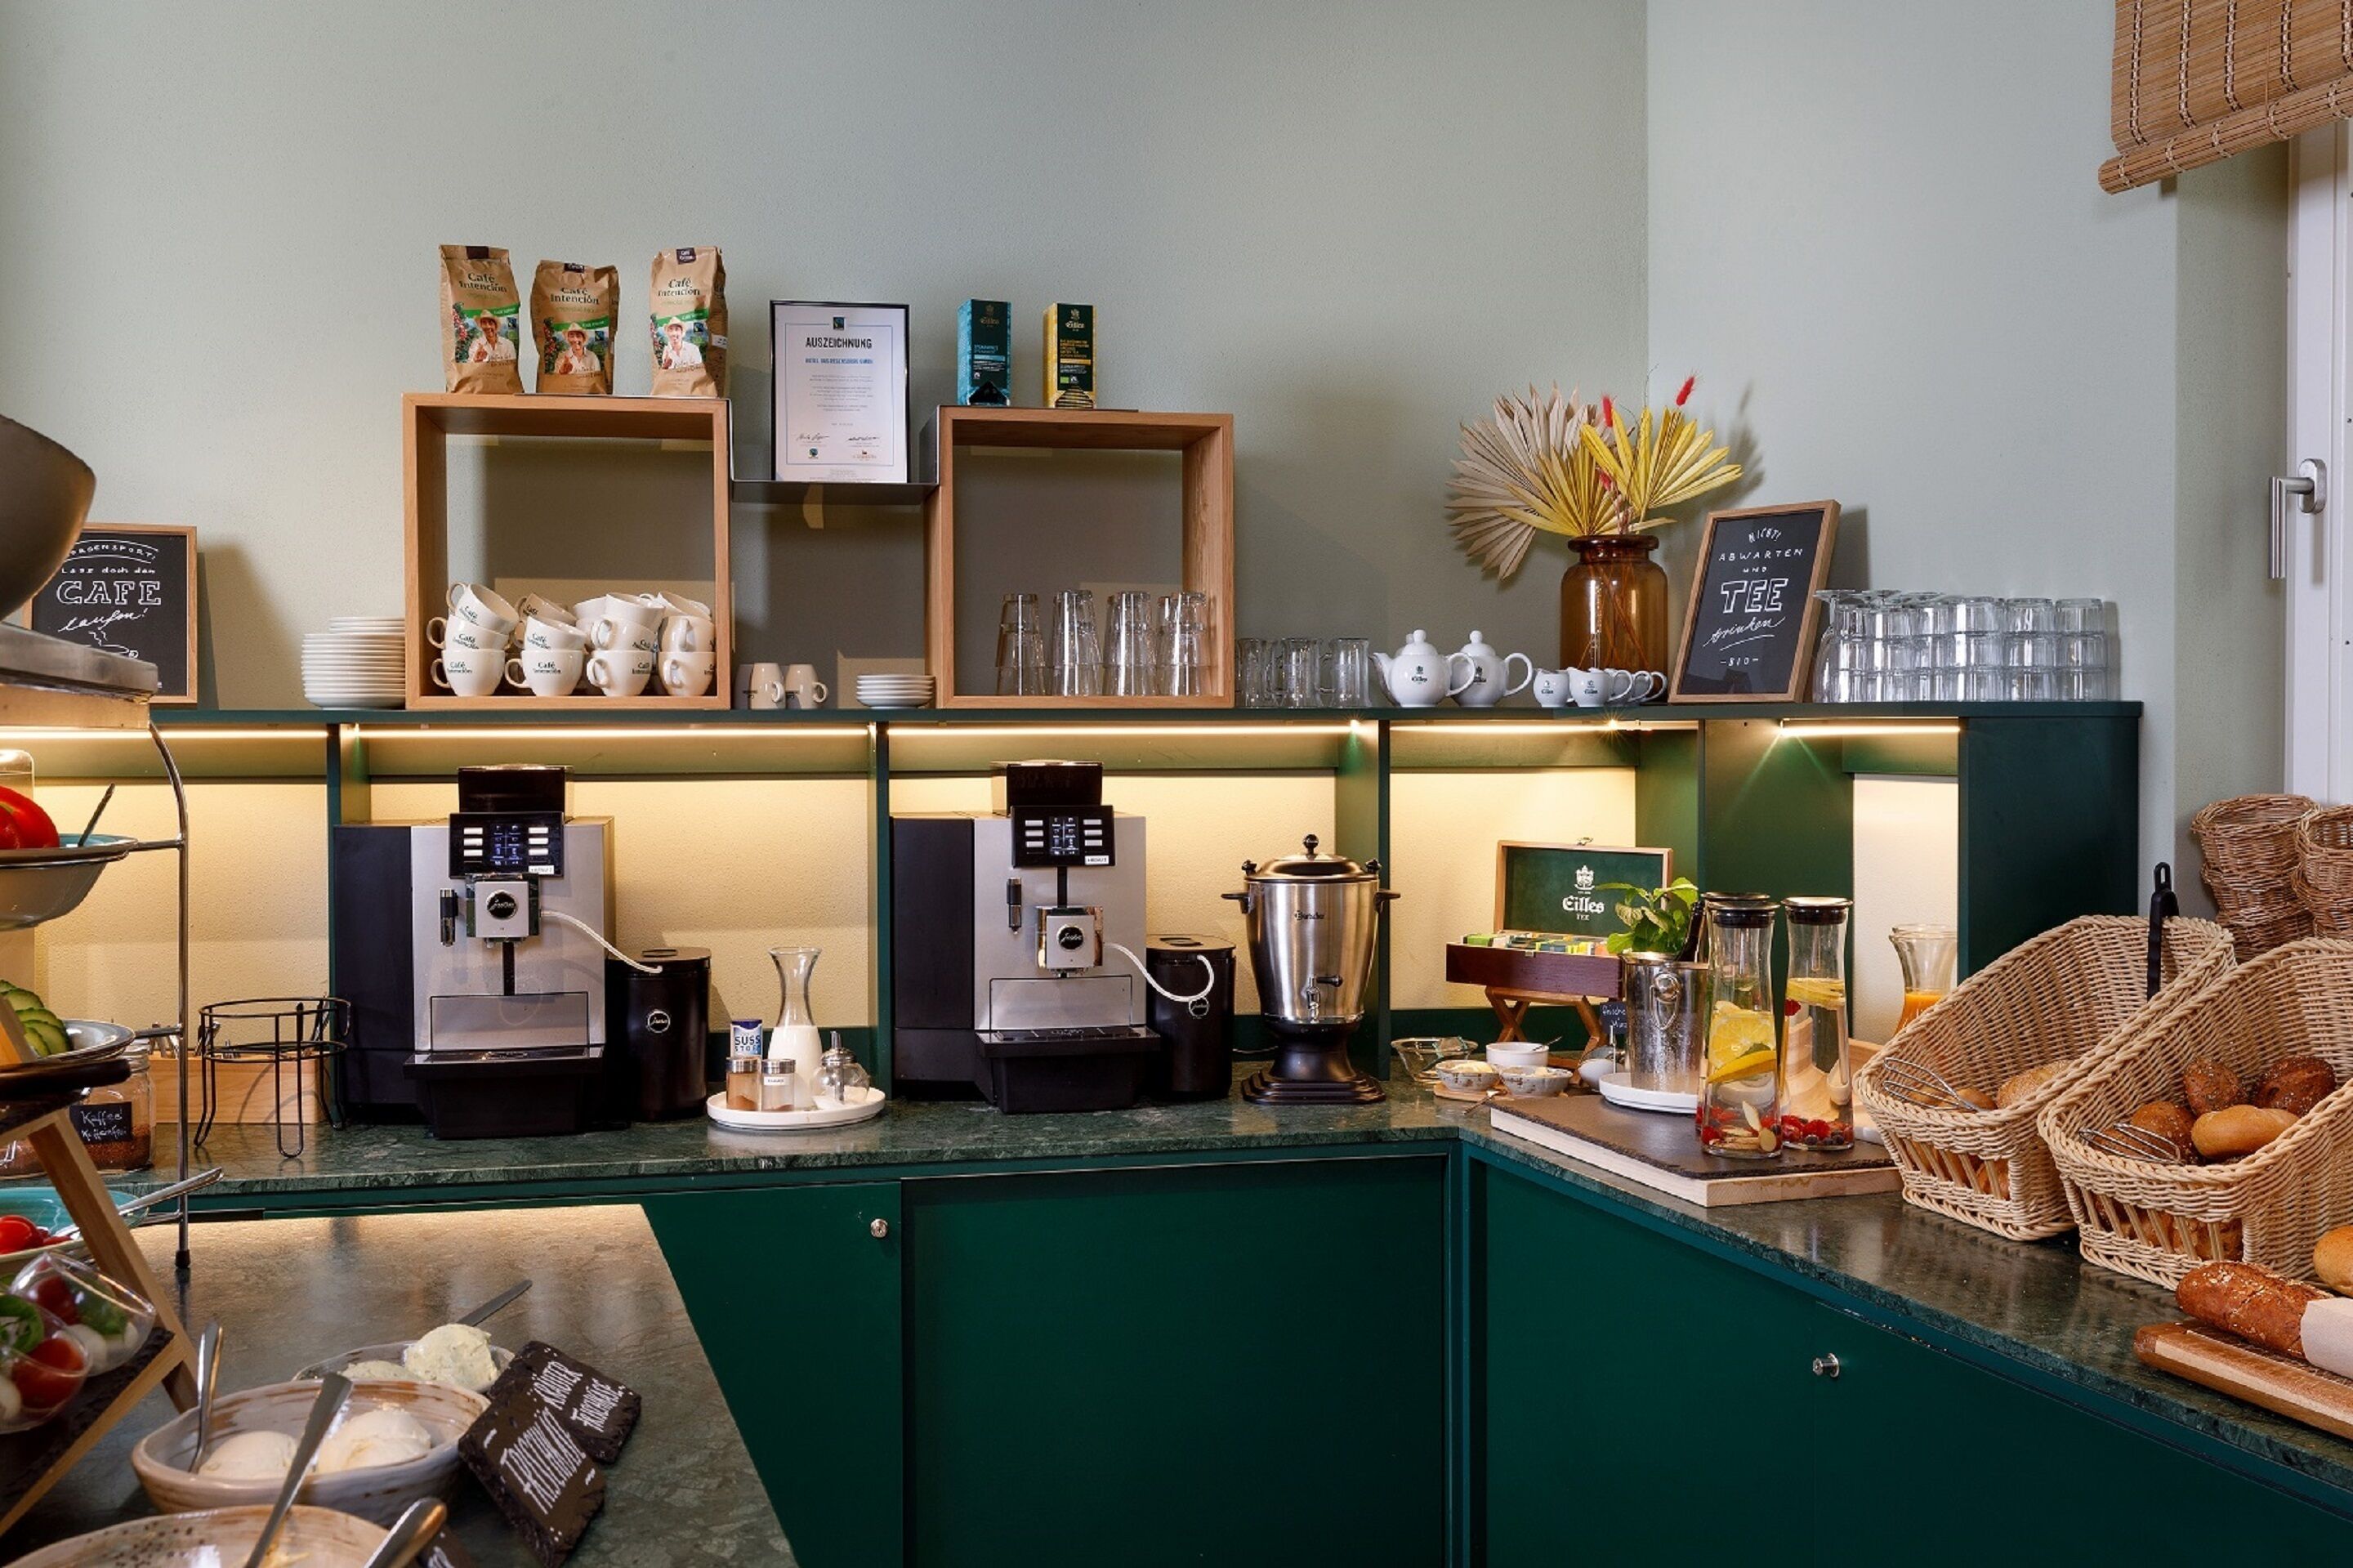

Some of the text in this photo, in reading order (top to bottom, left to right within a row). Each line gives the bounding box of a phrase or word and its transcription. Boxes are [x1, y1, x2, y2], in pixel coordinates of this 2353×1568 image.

[467, 272, 495, 284] Café
[668, 278, 691, 289] Café
[458, 280, 507, 293] Intención
[560, 287, 588, 295] Café
[657, 288, 700, 297] Intención
[550, 293, 600, 305] Intención
[806, 337, 873, 350] AUSZEICHNUNG
[1718, 548, 1803, 561] ABWARTEN
[56, 580, 162, 605] CAFE
[1721, 578, 1788, 614] TEE
[459, 633, 476, 644] Café
[1562, 896, 1605, 914] Eilles
[531, 1360, 583, 1410] KRÄUTER
[500, 1406, 587, 1515] FRISCHKÄSE
